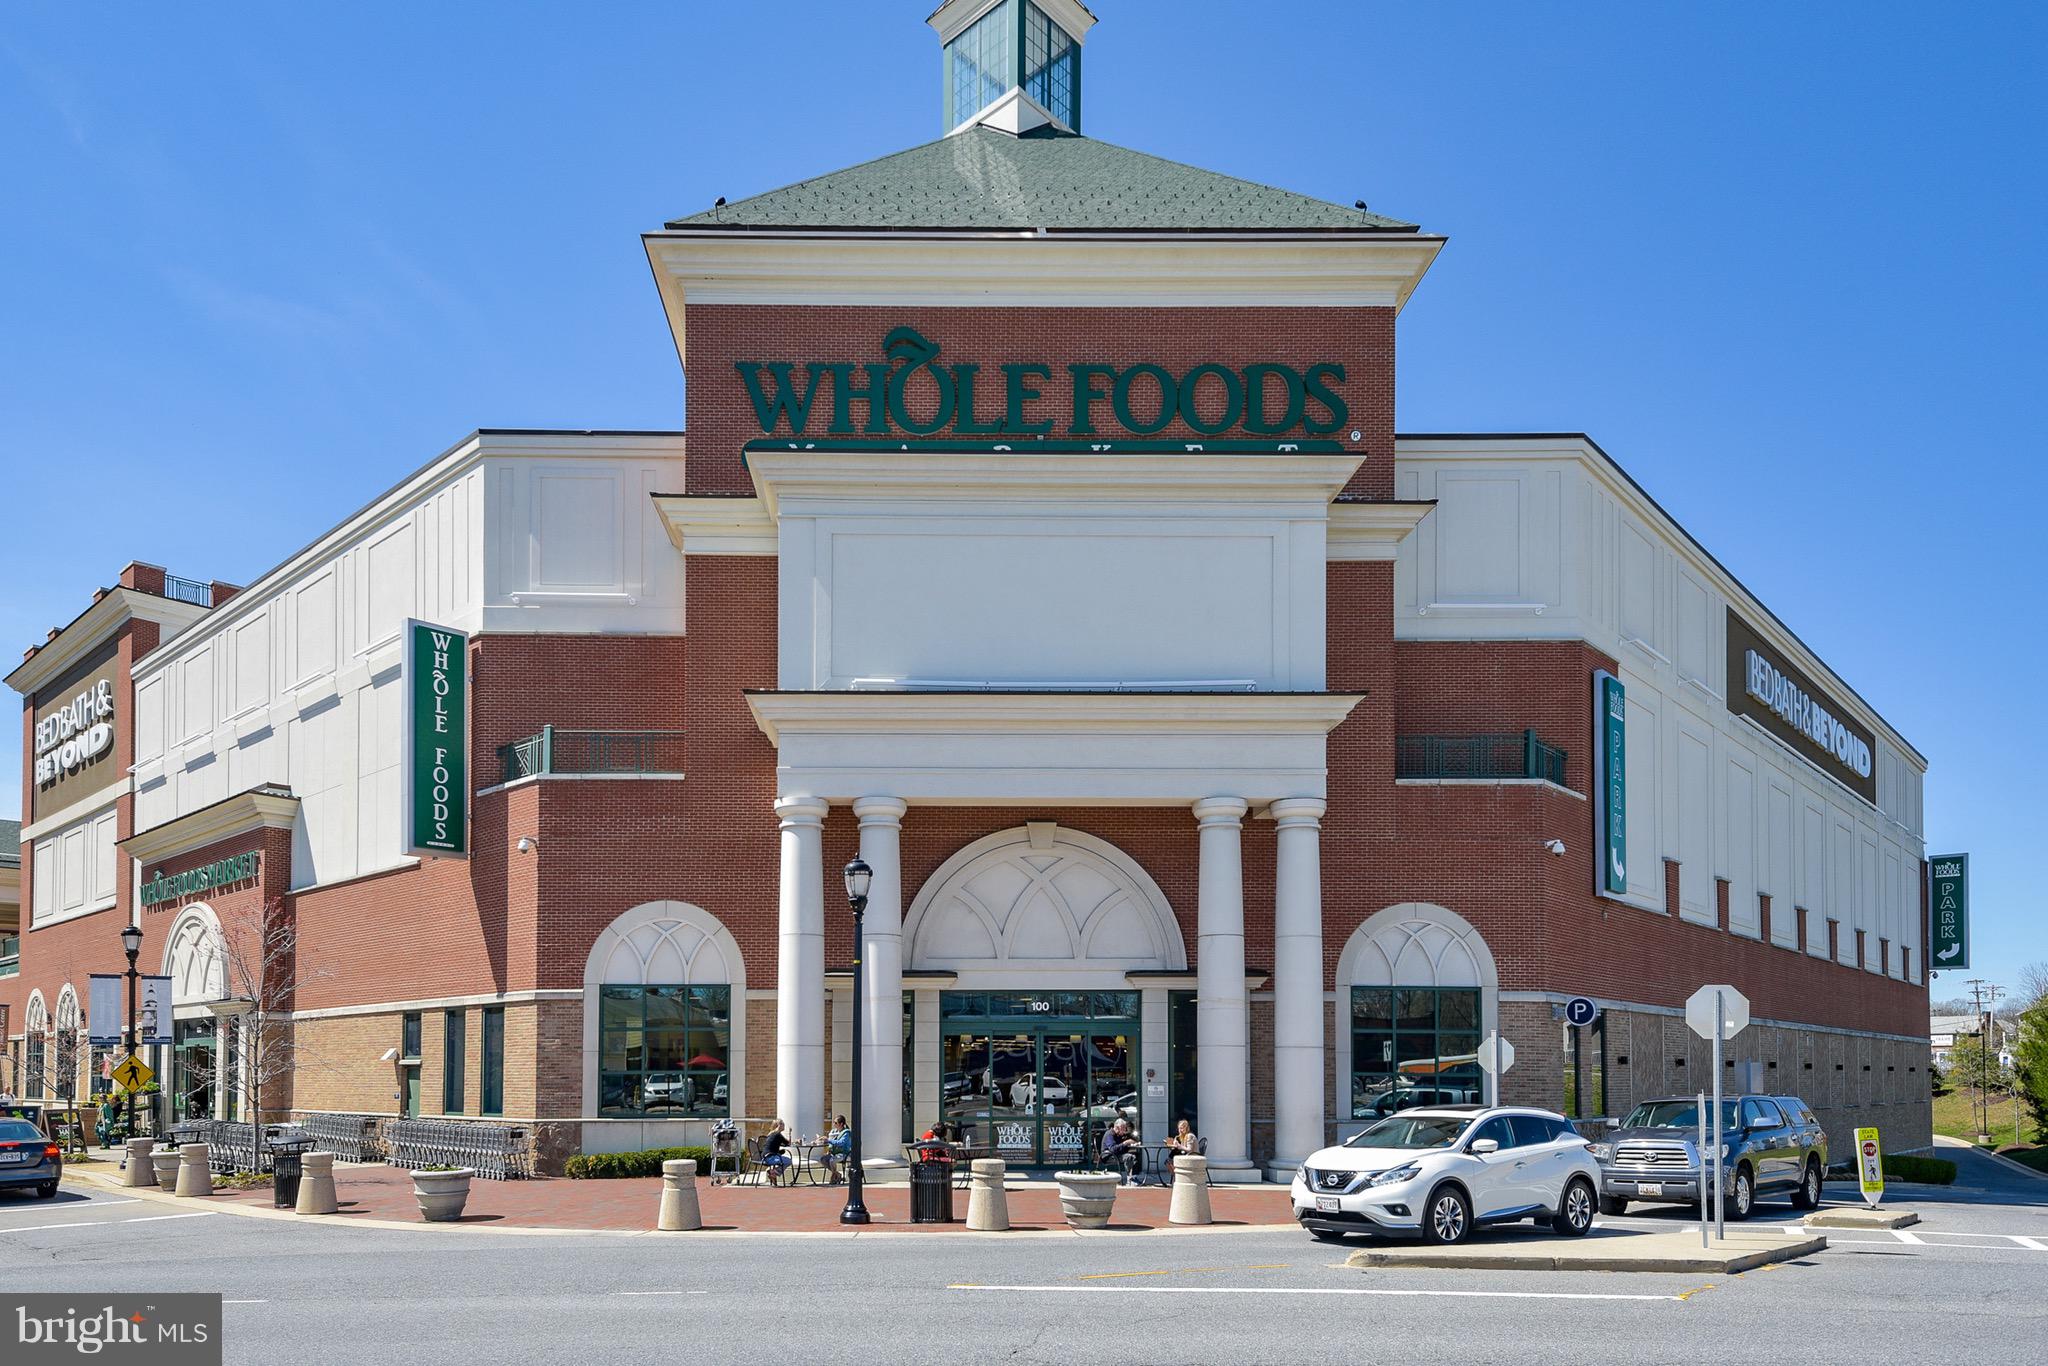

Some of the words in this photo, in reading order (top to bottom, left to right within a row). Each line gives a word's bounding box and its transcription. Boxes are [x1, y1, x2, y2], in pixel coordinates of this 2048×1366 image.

[734, 326, 1052, 437] WHOLE
[1067, 361, 1350, 437] FOODS
[430, 631, 452, 733] WHOLE
[36, 723, 112, 785] BEYOND
[1811, 701, 1871, 778] BEYOND
[432, 747, 449, 840] FOODS
[1613, 730, 1622, 838] PARK
[1940, 882, 1957, 938] PARK
[1031, 1001, 1049, 1011] 100
[1574, 1003, 1587, 1020] P
[996, 1122, 1032, 1135] WHOLE
[998, 1135, 1031, 1144] FOODS
[1048, 1122, 1084, 1135] WHOLE
[1049, 1135, 1083, 1144] FOODS
